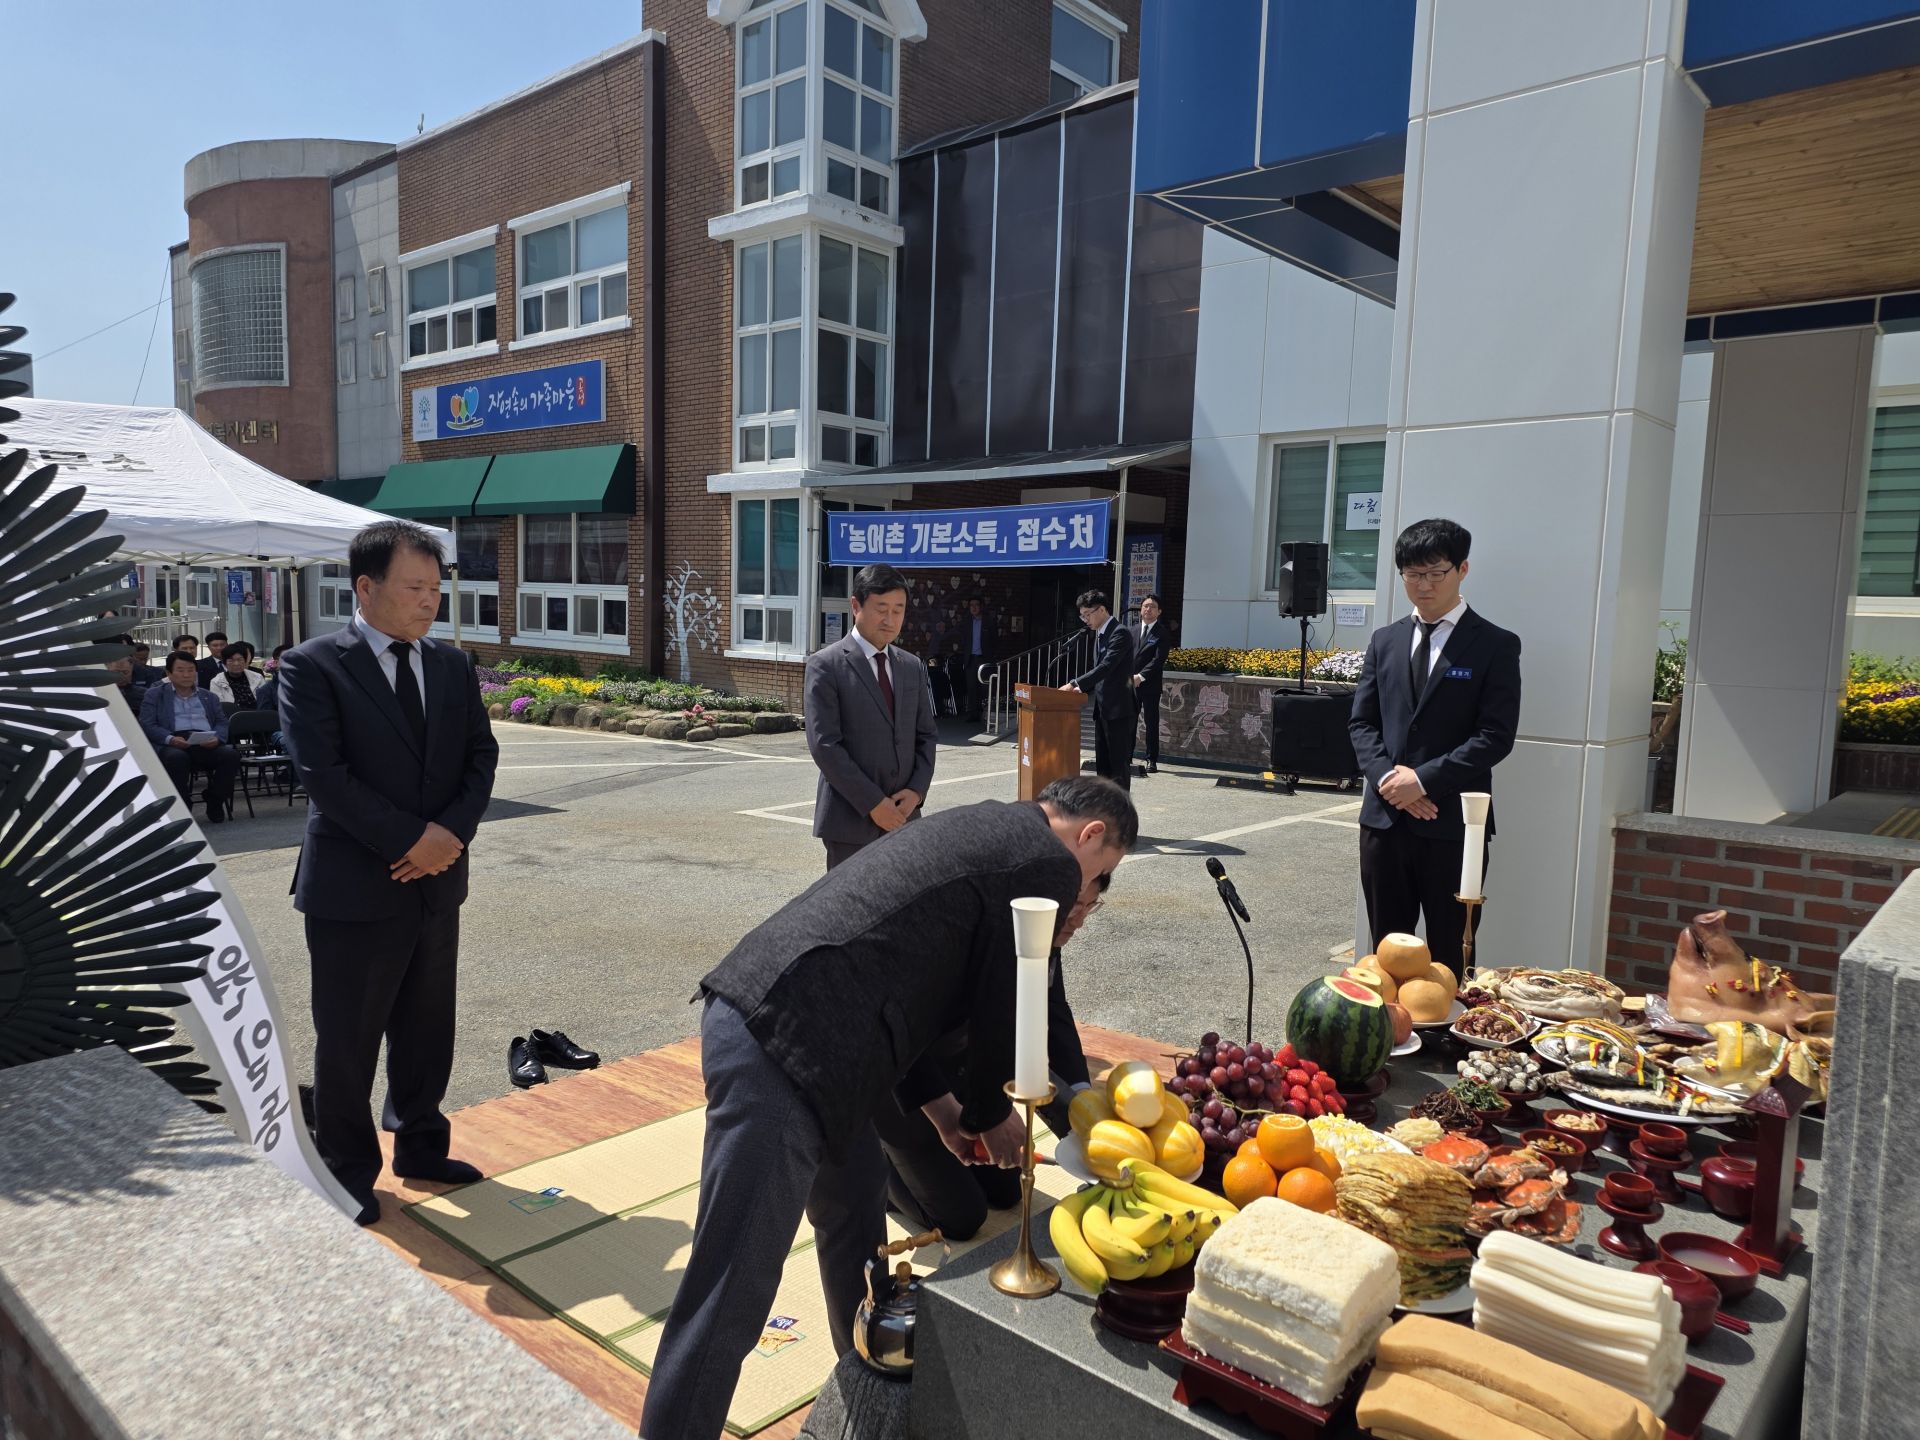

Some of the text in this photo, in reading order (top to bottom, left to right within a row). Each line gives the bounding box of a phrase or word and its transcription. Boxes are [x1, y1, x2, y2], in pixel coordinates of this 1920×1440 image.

[488, 376, 575, 419] 자연속의 가족마을
[840, 514, 1094, 555] 「농어촌 기본소득」 접수처
[1131, 542, 1154, 553] 곡성군
